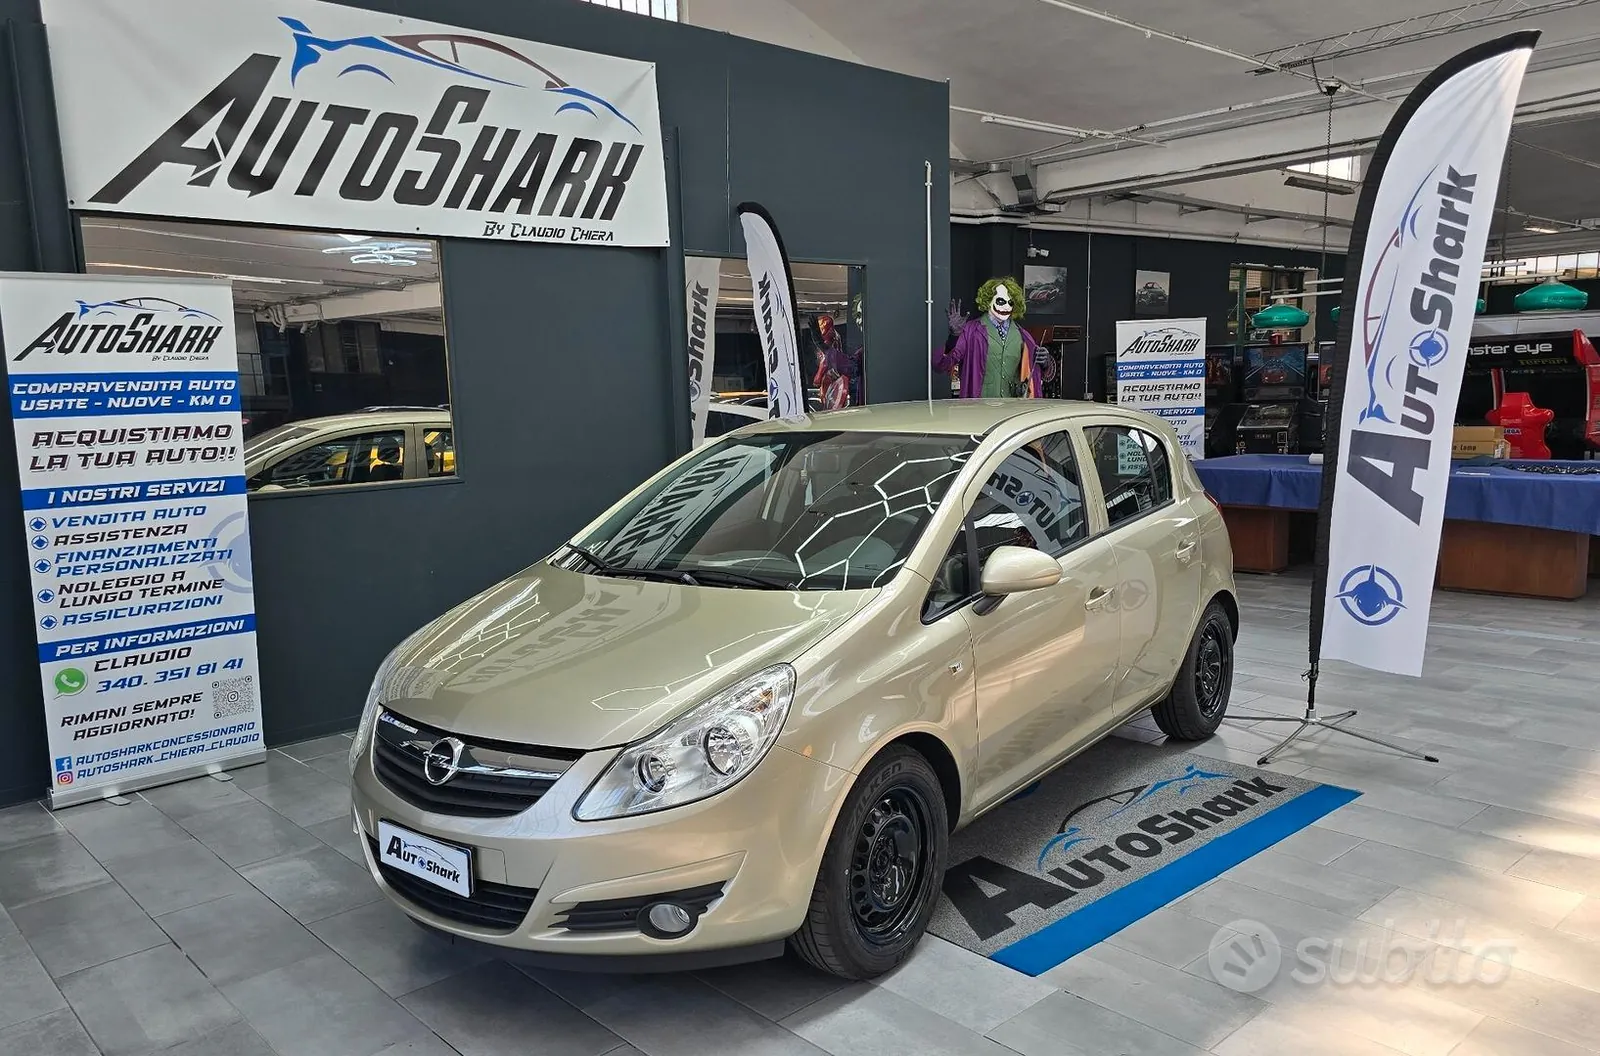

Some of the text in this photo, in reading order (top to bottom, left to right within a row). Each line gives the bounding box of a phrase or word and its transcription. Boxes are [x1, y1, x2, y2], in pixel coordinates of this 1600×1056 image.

[1514, 343, 1552, 354] eye
[1118, 363, 1183, 371] COMPRAVENDITA
[12, 380, 236, 395] COMPRAVENDITA AUTO
[1123, 383, 1201, 392] ACQUISTIAMO
[20, 398, 89, 411] USATE
[107, 395, 172, 408] NUOVE
[189, 395, 214, 406] KM
[32, 424, 233, 448] ACQUISTIAMO
[29, 446, 237, 472] LA TUA AUTO!!
[47, 480, 225, 504] I NOSTRI SERVIZI
[52, 505, 207, 528] VENDITA AUTO
[54, 523, 188, 546] ASSISTENZA
[55, 537, 218, 564] FINANZIAMENTI
[56, 549, 233, 578] PERSONALIZZATI
[58, 570, 186, 595] NOLEGGIO A
[59, 578, 225, 609] LUNGO TERMINE
[62, 594, 223, 626] ASSICURAZIONI
[55, 619, 245, 657] PER INFORMAZIONI
[94, 646, 192, 673] CLAUDIO
[96, 658, 244, 693] 340. 351 81 41
[60, 692, 204, 728] RIMANI SEMPRE
[73, 709, 195, 741] AGGIORNATO!
[76, 721, 256, 766] AUTOSHARKCONCESSIONARIO
[77, 732, 260, 779] AUTOSHARK_CHIERA_CLAUDIO
